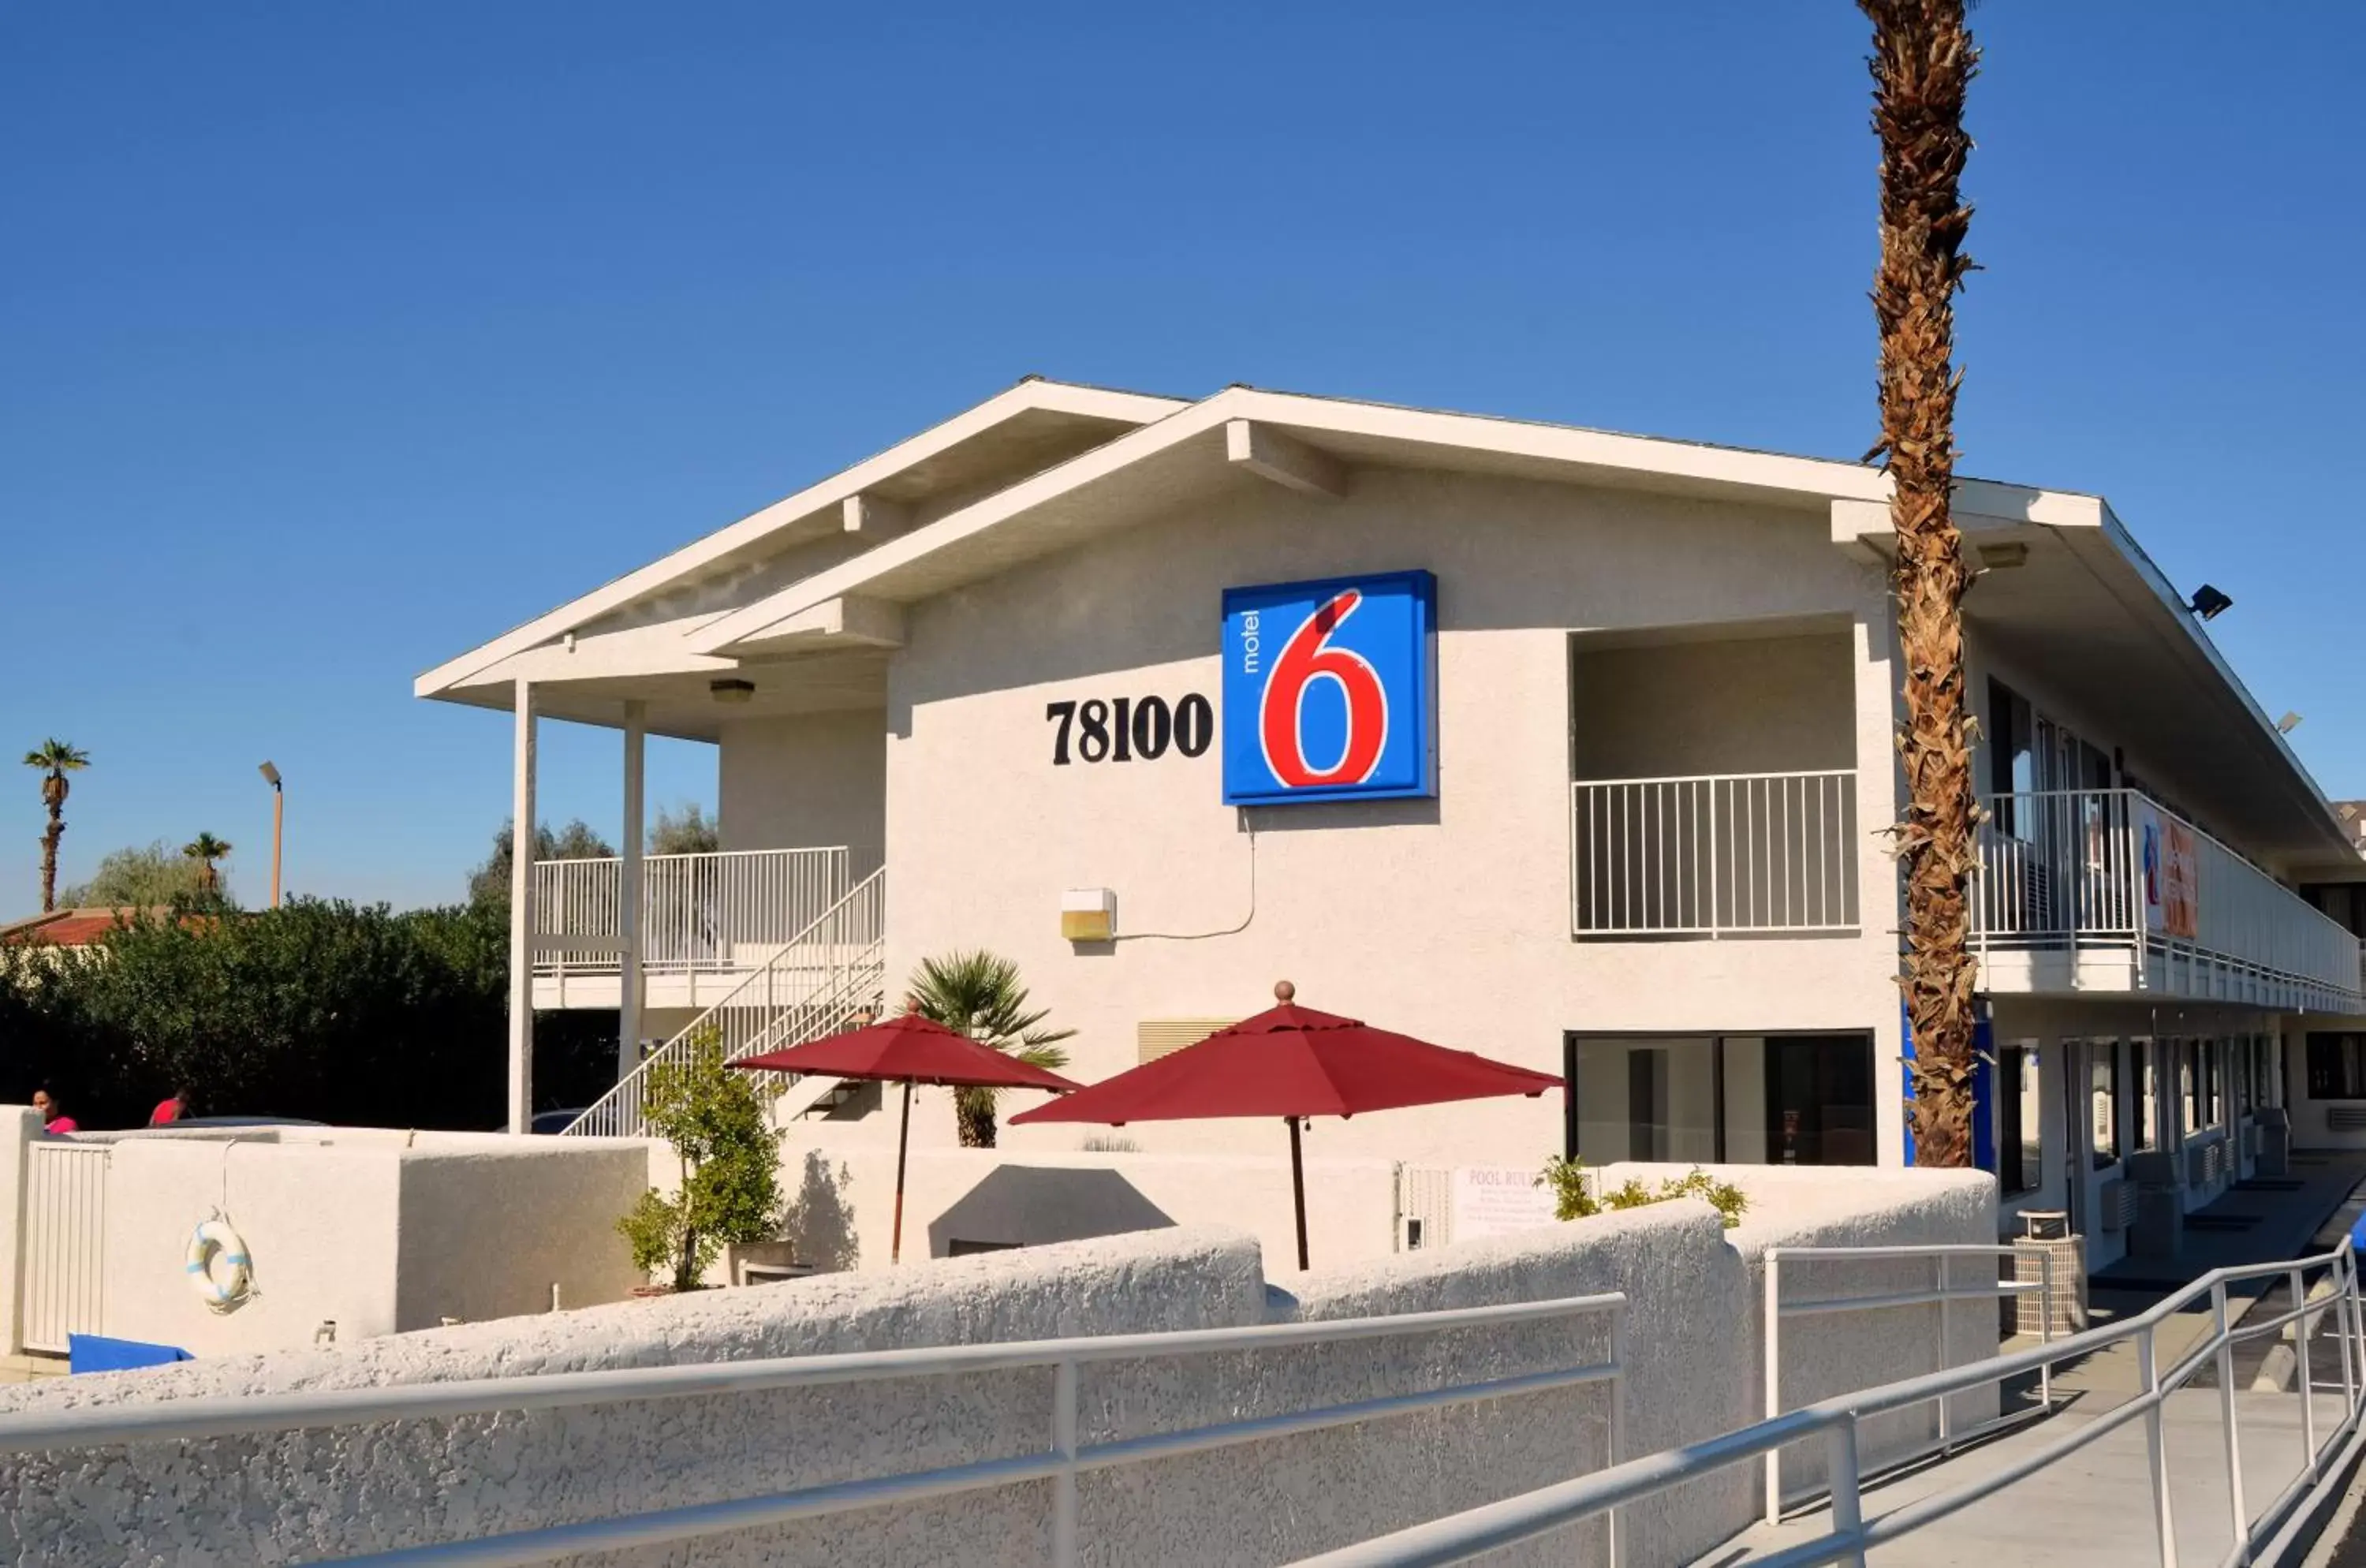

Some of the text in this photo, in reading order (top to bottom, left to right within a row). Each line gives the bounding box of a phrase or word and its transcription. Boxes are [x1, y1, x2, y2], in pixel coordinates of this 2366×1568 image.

[1241, 610, 1260, 674] motel
[1260, 588, 1389, 788] 6
[1047, 693, 1213, 766] 78100
[1469, 1170, 1540, 1186] POOL RULE
